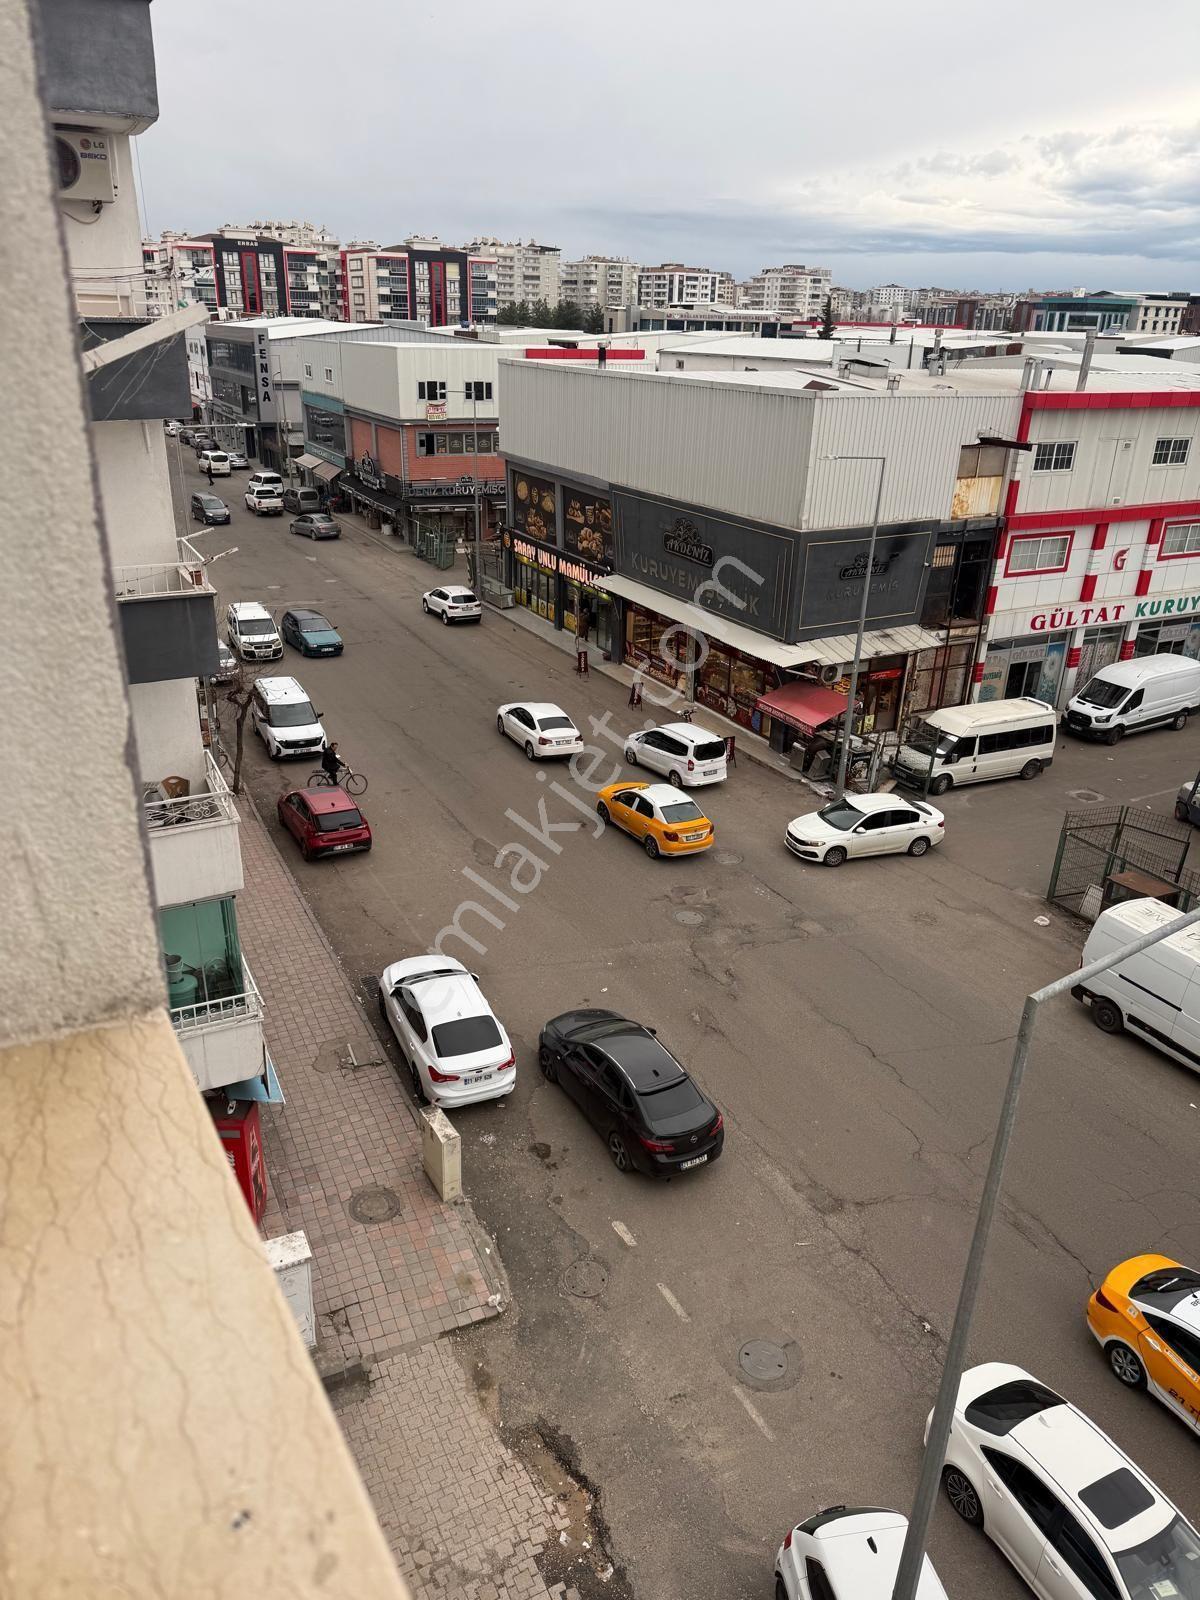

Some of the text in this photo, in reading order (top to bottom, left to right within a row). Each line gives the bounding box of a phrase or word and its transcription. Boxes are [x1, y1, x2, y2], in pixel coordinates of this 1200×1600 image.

[80, 152, 107, 160] BEKO
[92, 141, 105, 149] LG
[257, 334, 271, 402] FENSA
[514, 539, 536, 560] SARAY
[537, 549, 557, 570] UNLU
[1030, 605, 1126, 631] GÜLTAT
